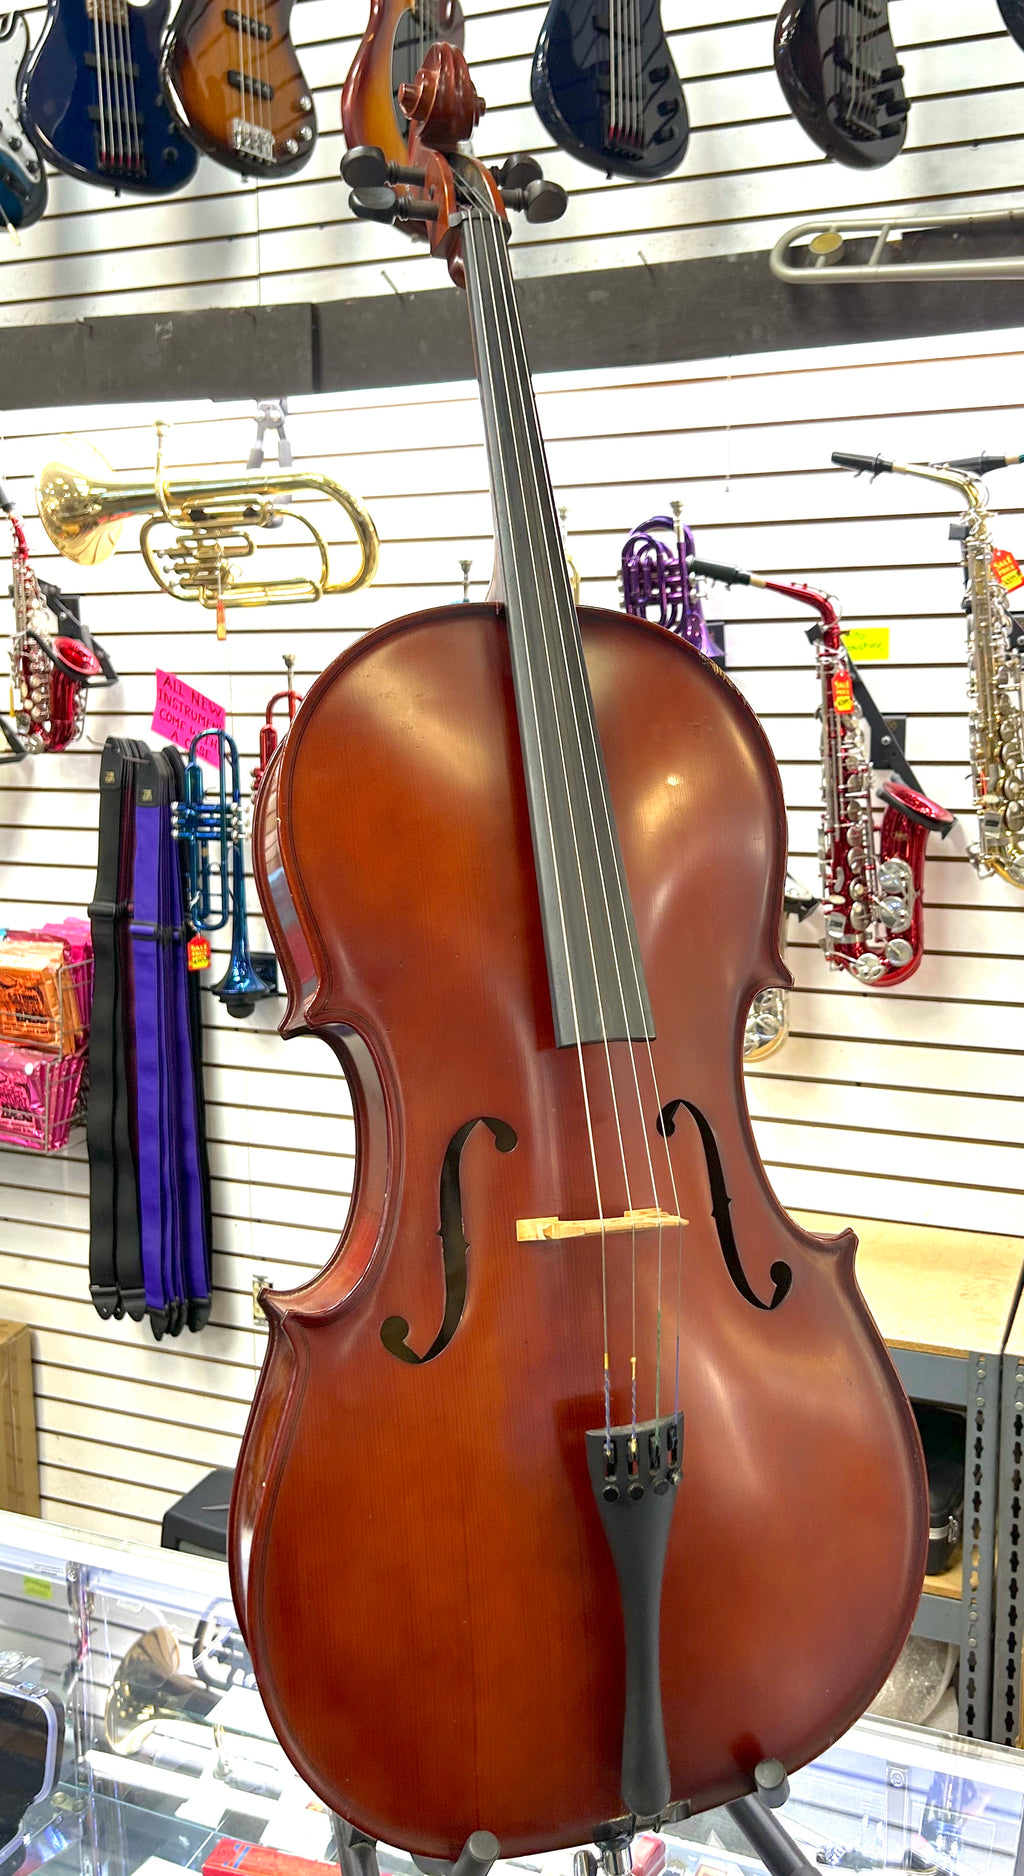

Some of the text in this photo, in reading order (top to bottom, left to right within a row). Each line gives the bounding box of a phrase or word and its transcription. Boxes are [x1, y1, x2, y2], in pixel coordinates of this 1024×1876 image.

[993, 555, 1012, 568] SALE
[163, 675, 222, 717] ALL NEW
[159, 708, 218, 750] COME WTH
[170, 730, 211, 759] A CSE
